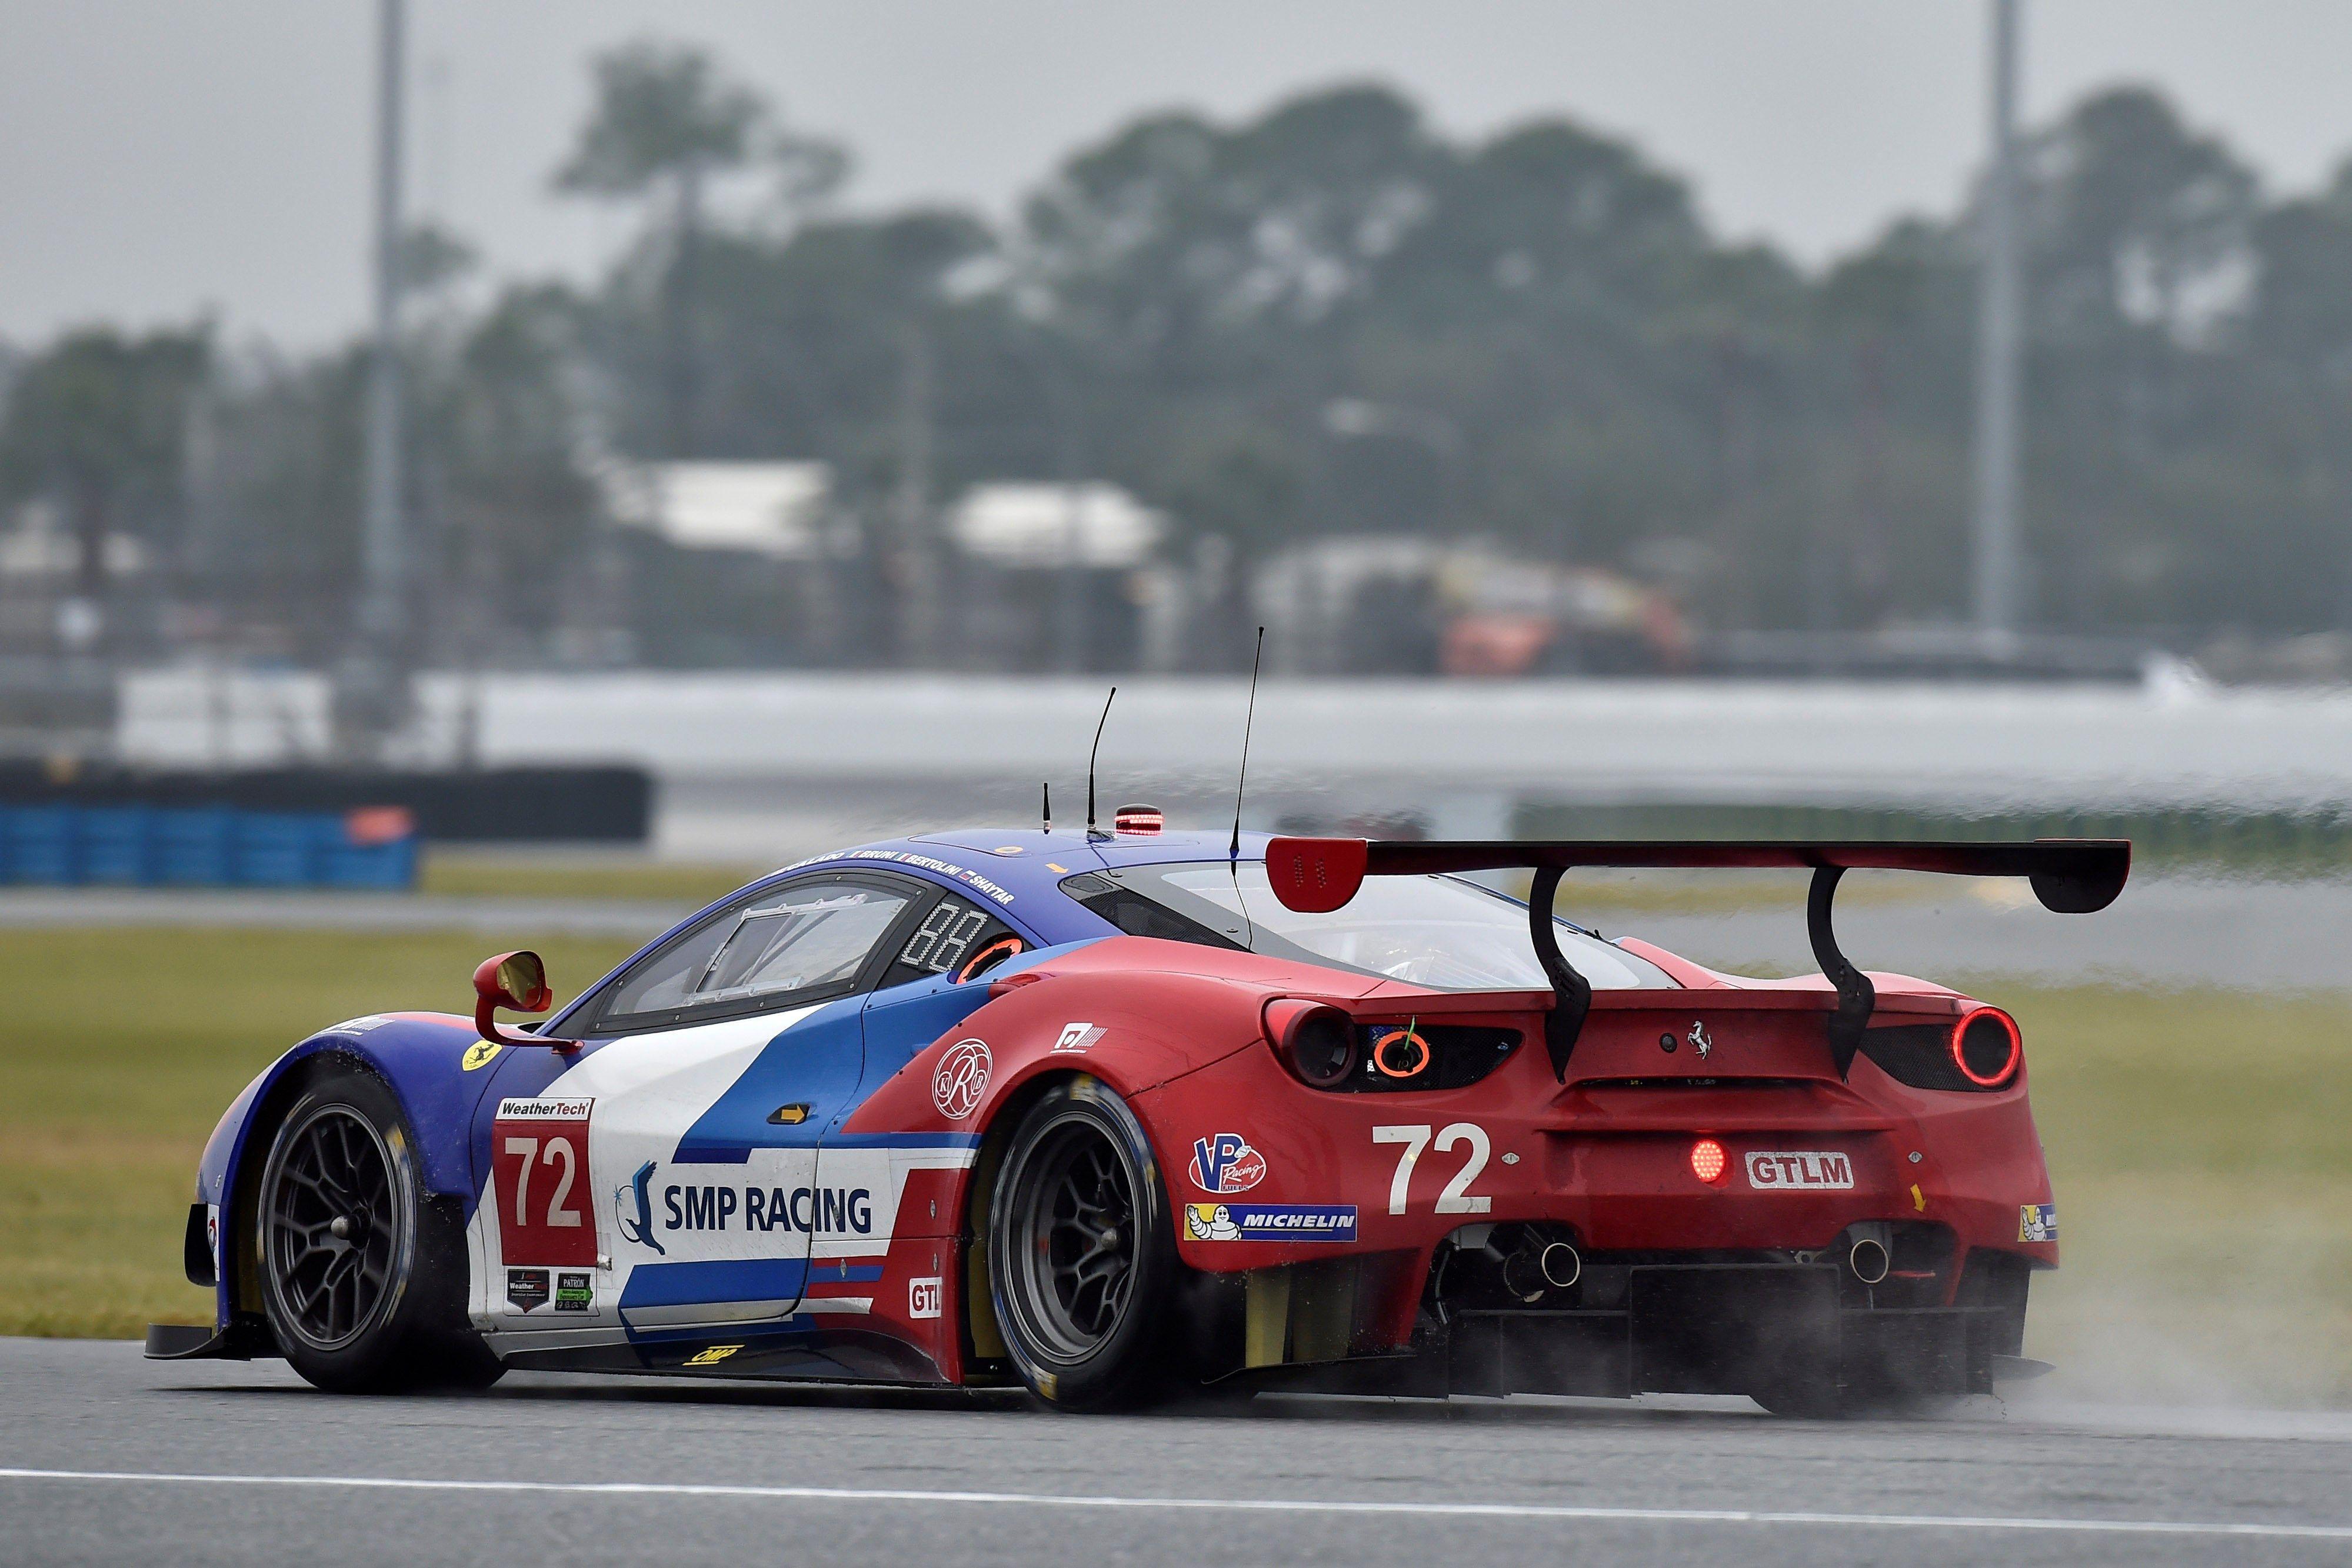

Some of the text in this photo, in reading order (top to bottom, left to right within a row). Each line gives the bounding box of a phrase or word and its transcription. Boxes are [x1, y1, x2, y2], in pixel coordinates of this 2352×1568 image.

[860, 850, 899, 859] BRUNI
[907, 854, 964, 876] BERTOLINI
[969, 875, 1015, 906] SHAYTAR
[502, 1102, 588, 1116] WeatherTech
[505, 1136, 582, 1227] 72
[1194, 1133, 1245, 1192] VP
[1223, 1164, 1265, 1184] Racing
[1372, 1122, 1493, 1216] 72
[1752, 1156, 1848, 1184] GTLM
[665, 1185, 872, 1234] SMP RACING
[1244, 1214, 1355, 1228] MICHELIN
